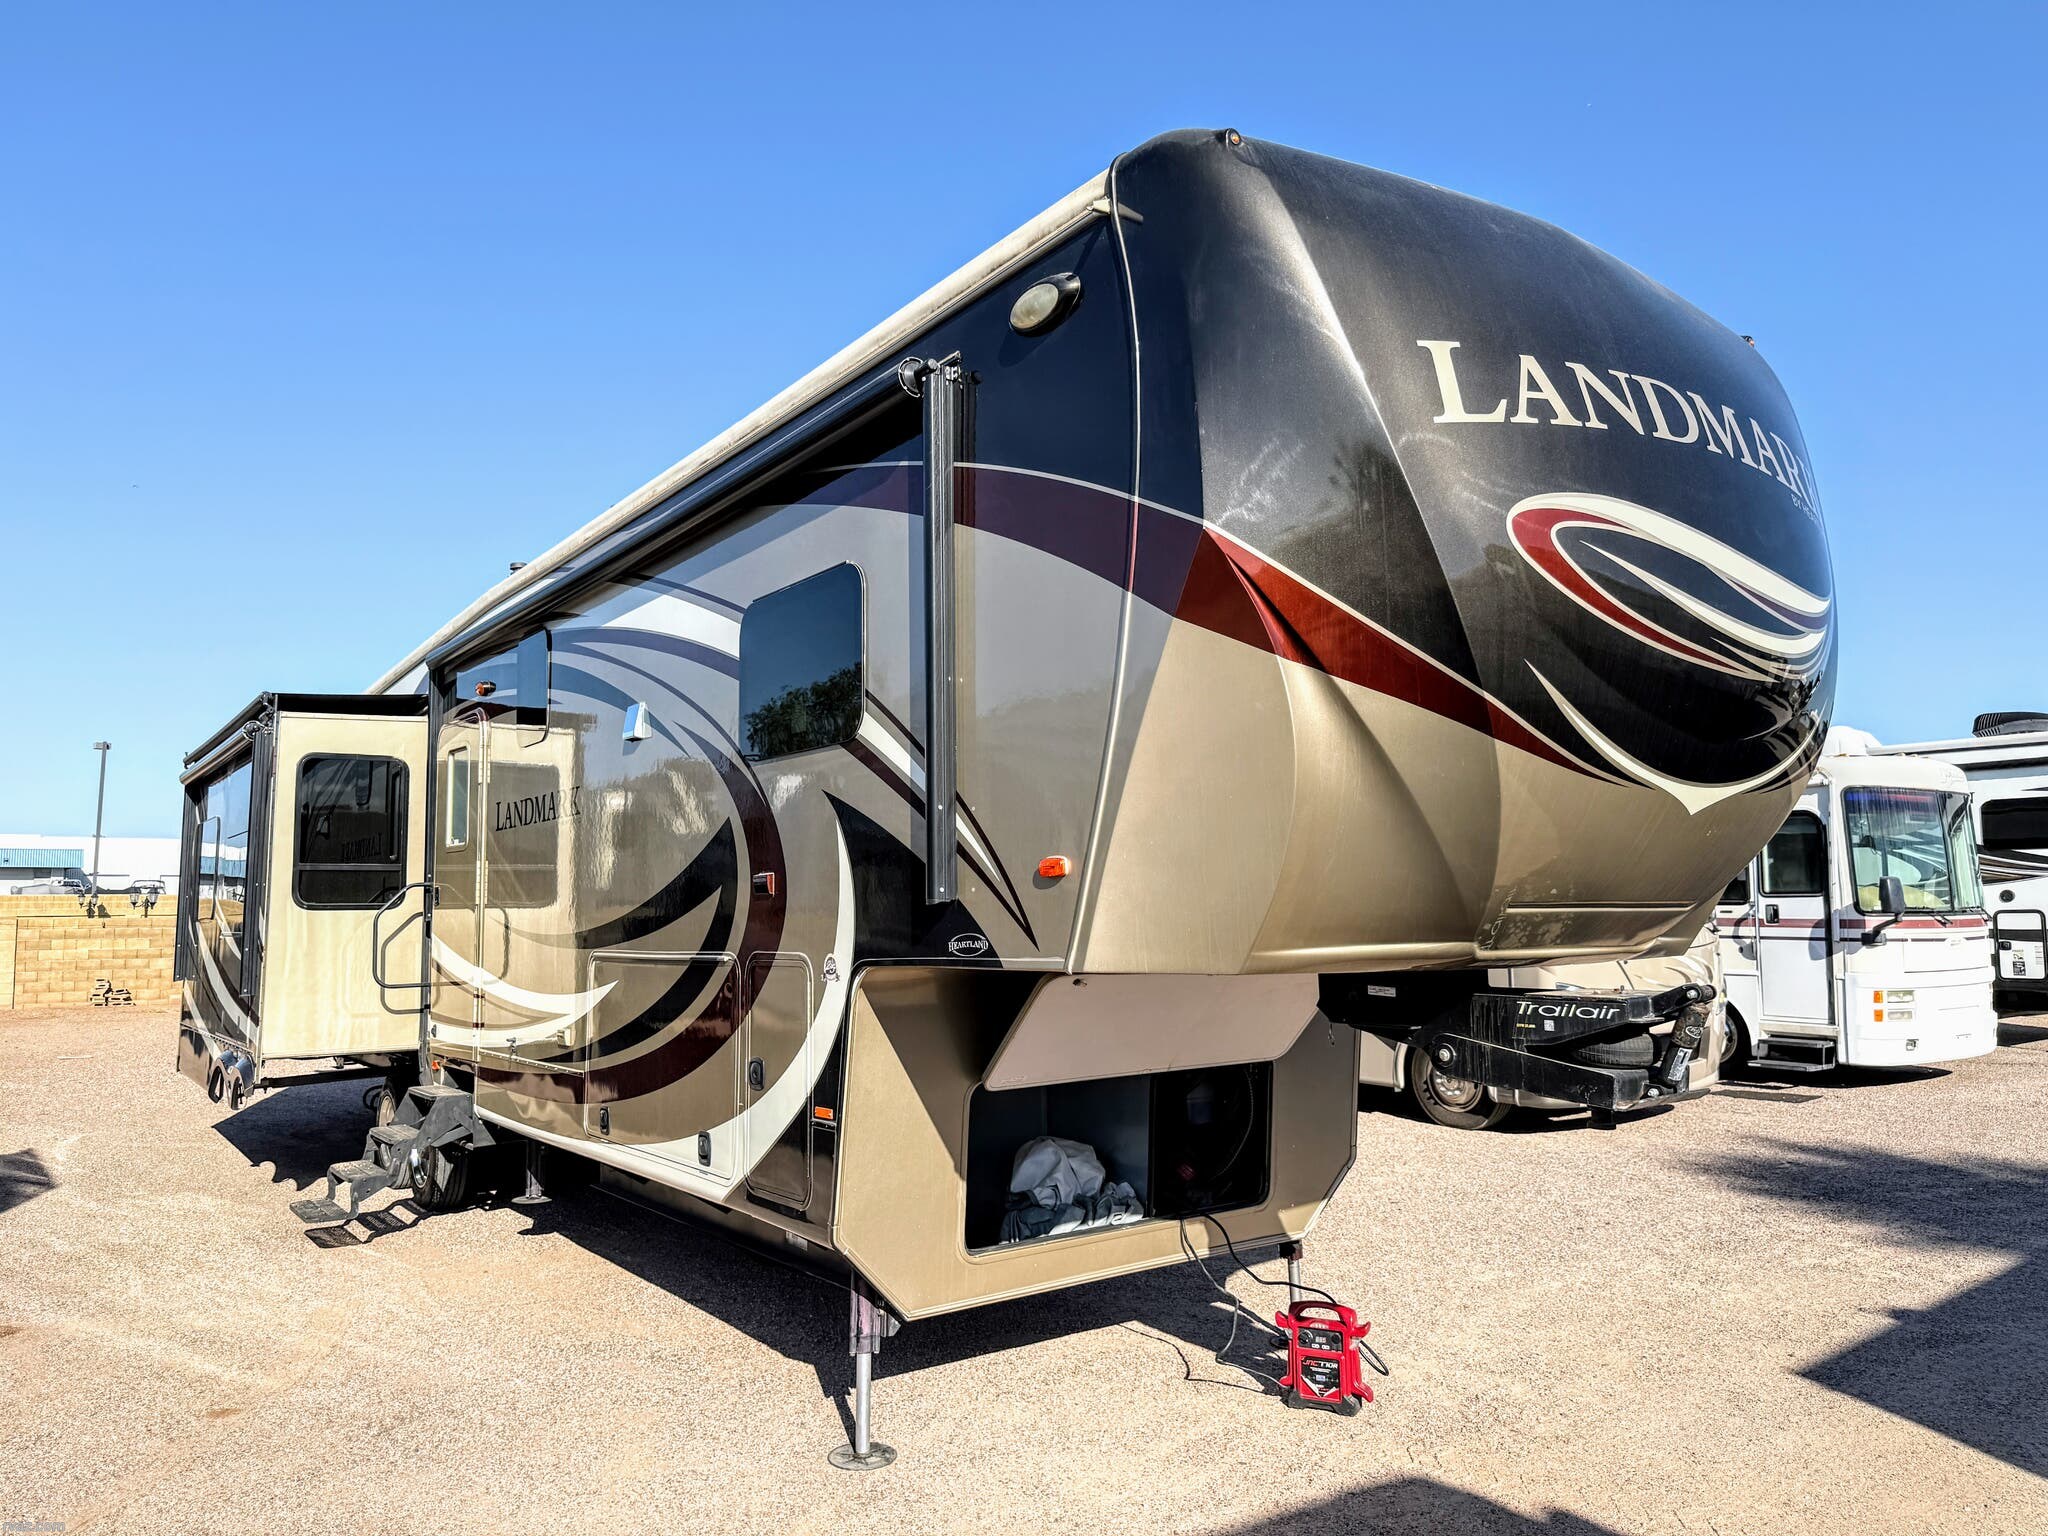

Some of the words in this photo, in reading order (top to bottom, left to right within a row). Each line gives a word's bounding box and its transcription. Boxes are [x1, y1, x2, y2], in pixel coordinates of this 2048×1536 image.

[1416, 339, 1821, 523] LANDMARK
[496, 786, 581, 832] LANDMARK
[948, 940, 989, 952] HEARTLAND
[1516, 1001, 1620, 1019] Trailair
